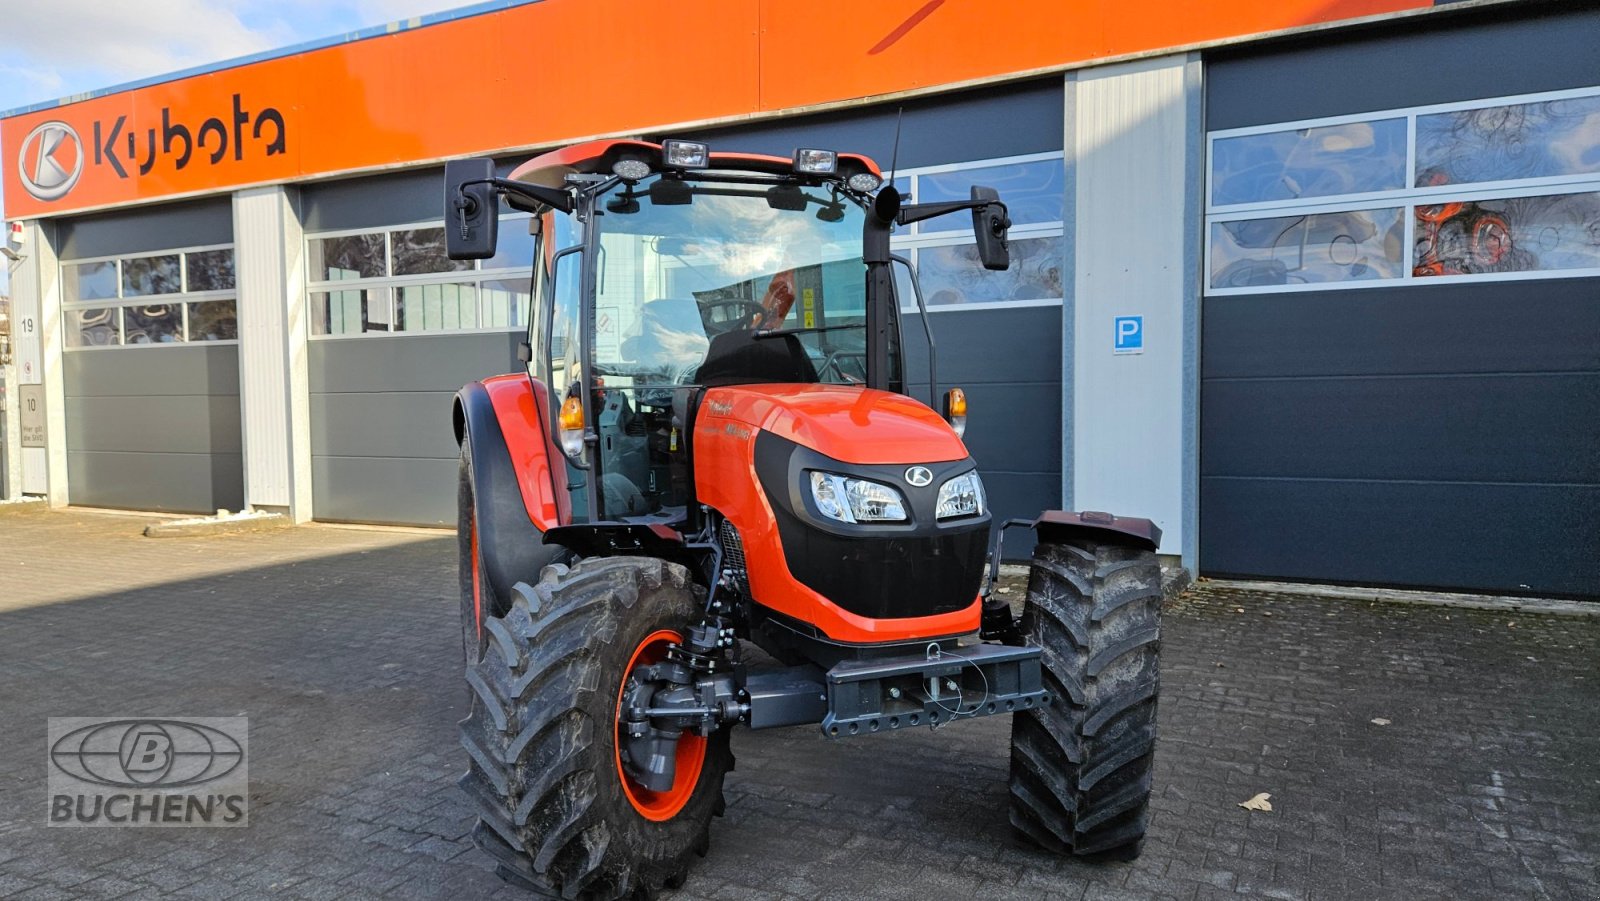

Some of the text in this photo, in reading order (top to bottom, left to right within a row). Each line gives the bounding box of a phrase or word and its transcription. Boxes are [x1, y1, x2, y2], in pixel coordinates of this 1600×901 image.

[94, 93, 287, 179] Kubota
[22, 318, 33, 333] 19
[1118, 320, 1139, 345] P
[27, 398, 36, 412] 10
